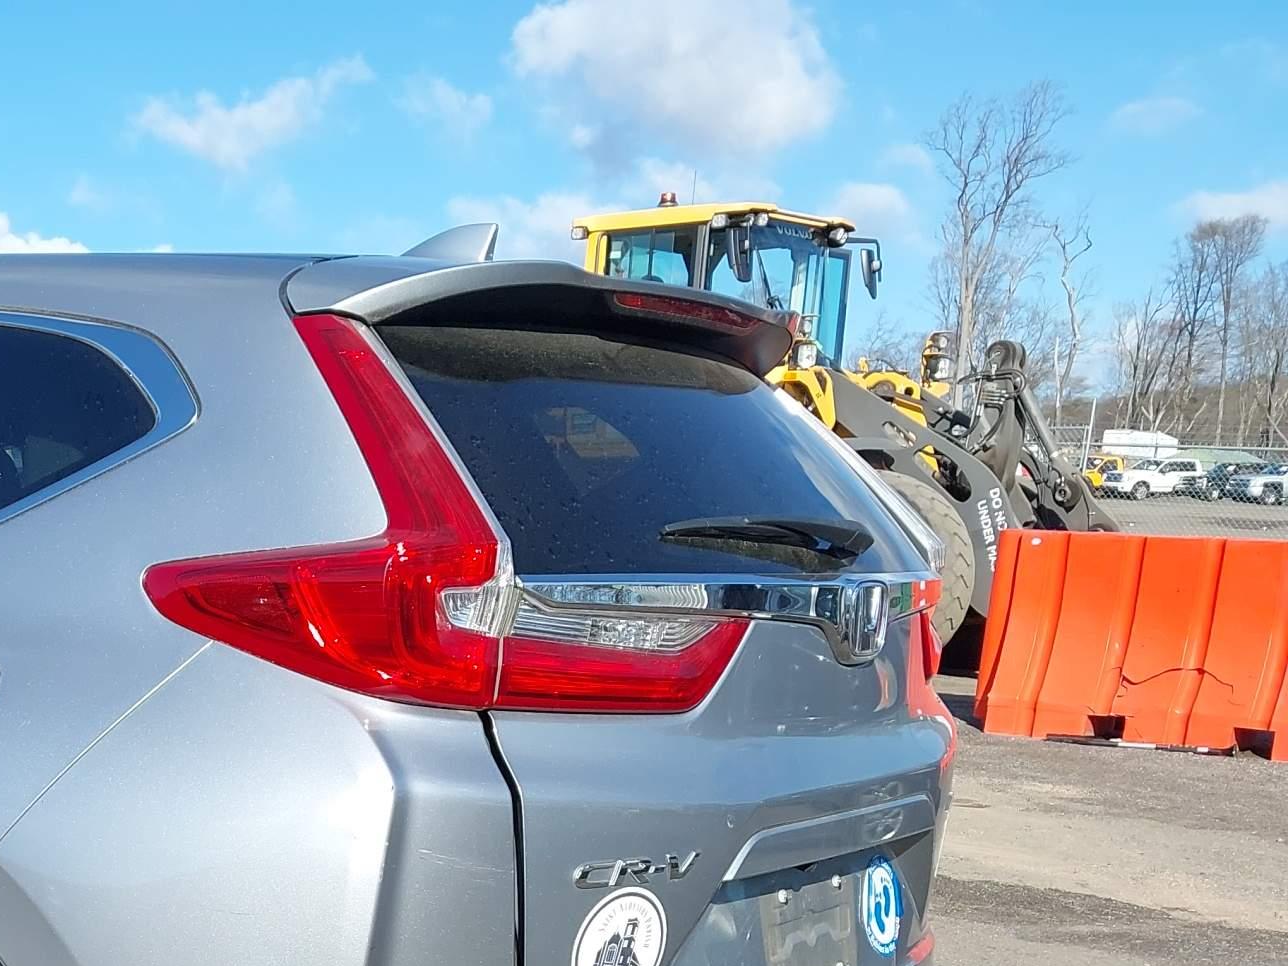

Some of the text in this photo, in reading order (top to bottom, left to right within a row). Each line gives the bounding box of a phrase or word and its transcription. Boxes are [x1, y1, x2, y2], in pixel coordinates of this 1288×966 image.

[977, 499, 995, 545] UNDER
[989, 487, 1008, 531] DO NO
[573, 852, 700, 889] CR-V
